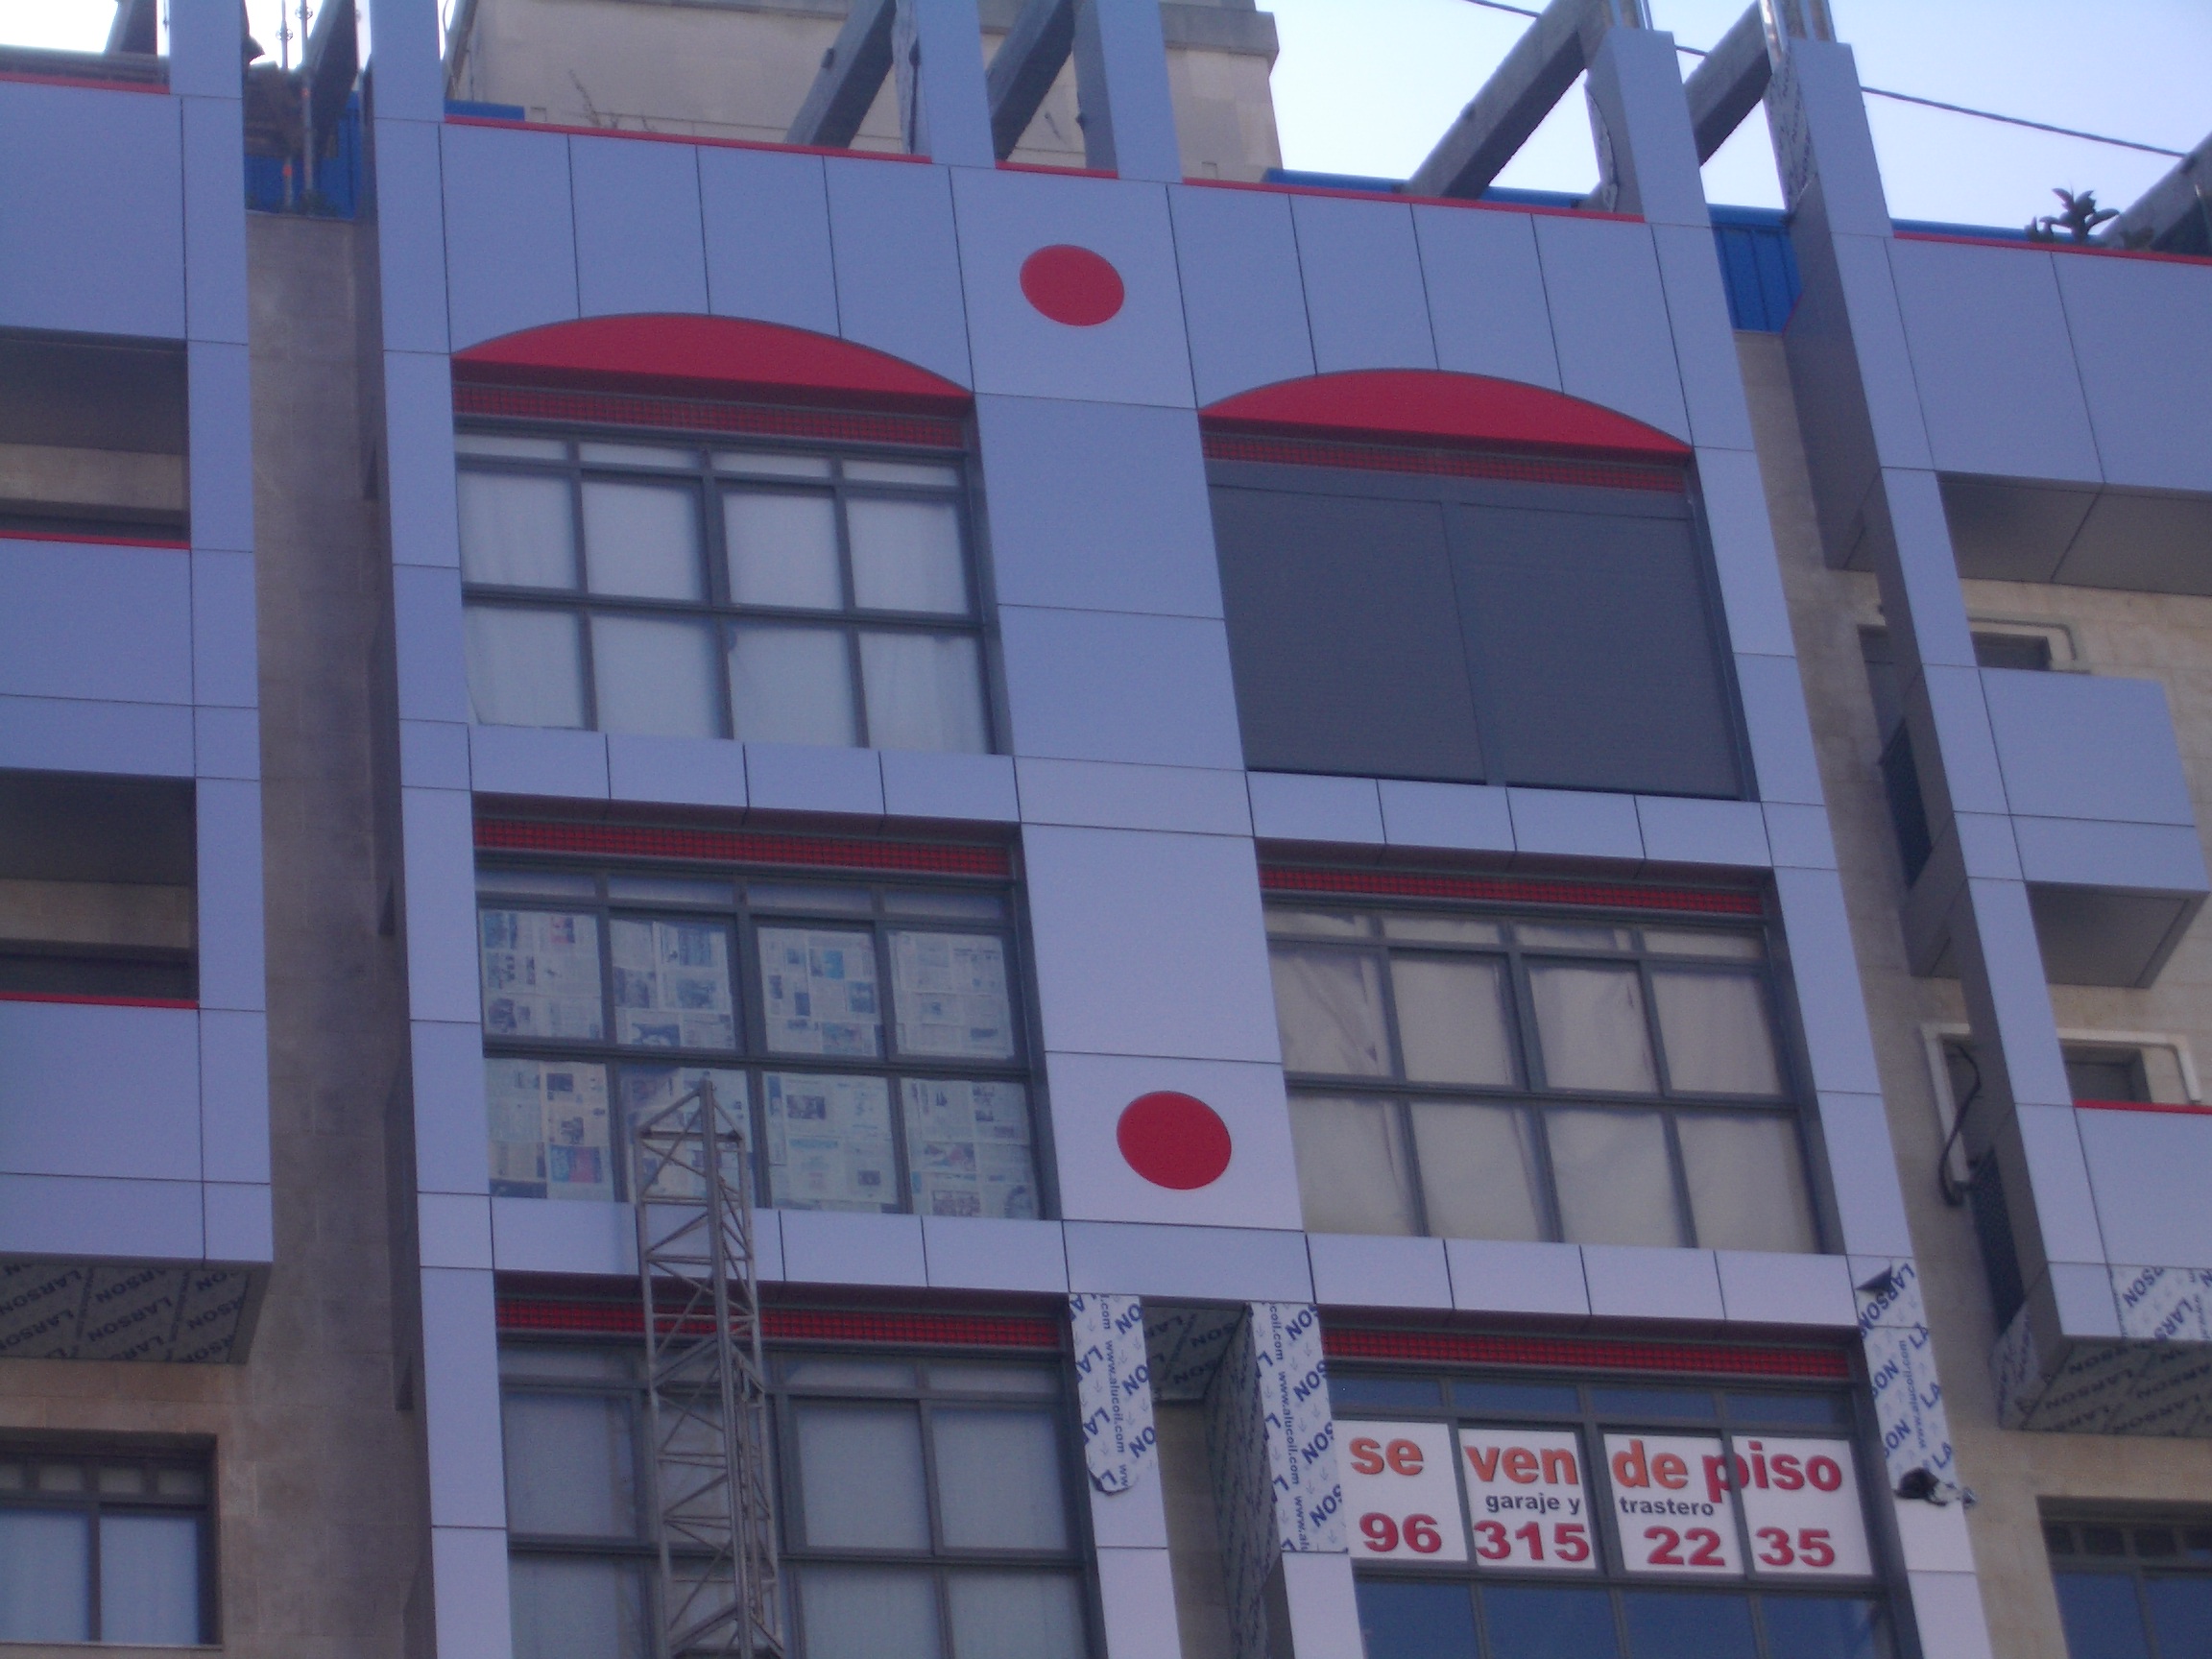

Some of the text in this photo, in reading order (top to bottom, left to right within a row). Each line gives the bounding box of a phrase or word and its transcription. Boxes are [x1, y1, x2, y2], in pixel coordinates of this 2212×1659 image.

[1351, 1436, 1424, 1477] se
[1703, 1439, 1842, 1503] piso
[1485, 1492, 1716, 1518] garaje y trastero
[1359, 1512, 1836, 1568] 96 315 22 35
